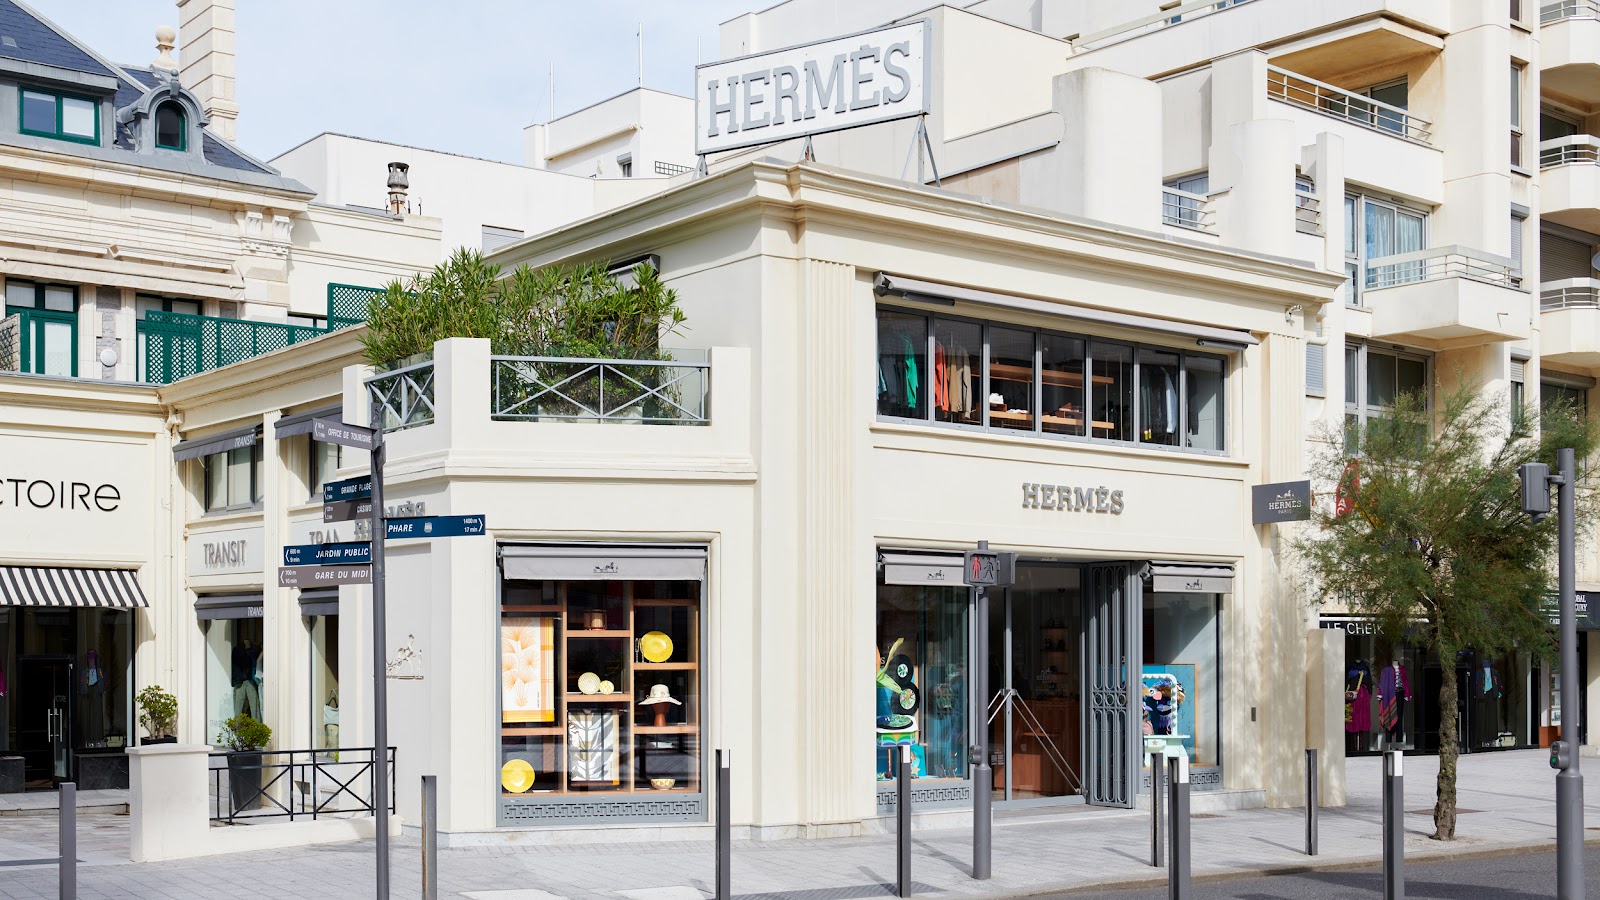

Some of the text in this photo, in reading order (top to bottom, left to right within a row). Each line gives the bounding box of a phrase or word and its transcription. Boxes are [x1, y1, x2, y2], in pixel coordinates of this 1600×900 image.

[707, 40, 912, 138] HERMÈS
[327, 428, 372, 444] OFFICE DE TOURISME
[0, 478, 121, 512] TOIRe
[341, 484, 358, 495] GRANDE
[1022, 481, 1125, 515] HERMÈS
[387, 523, 414, 533] PHARE
[203, 539, 247, 567] TRANSIT
[315, 547, 369, 559] JARDIN PUBLIC
[315, 569, 369, 580] GARE DU MIDI
